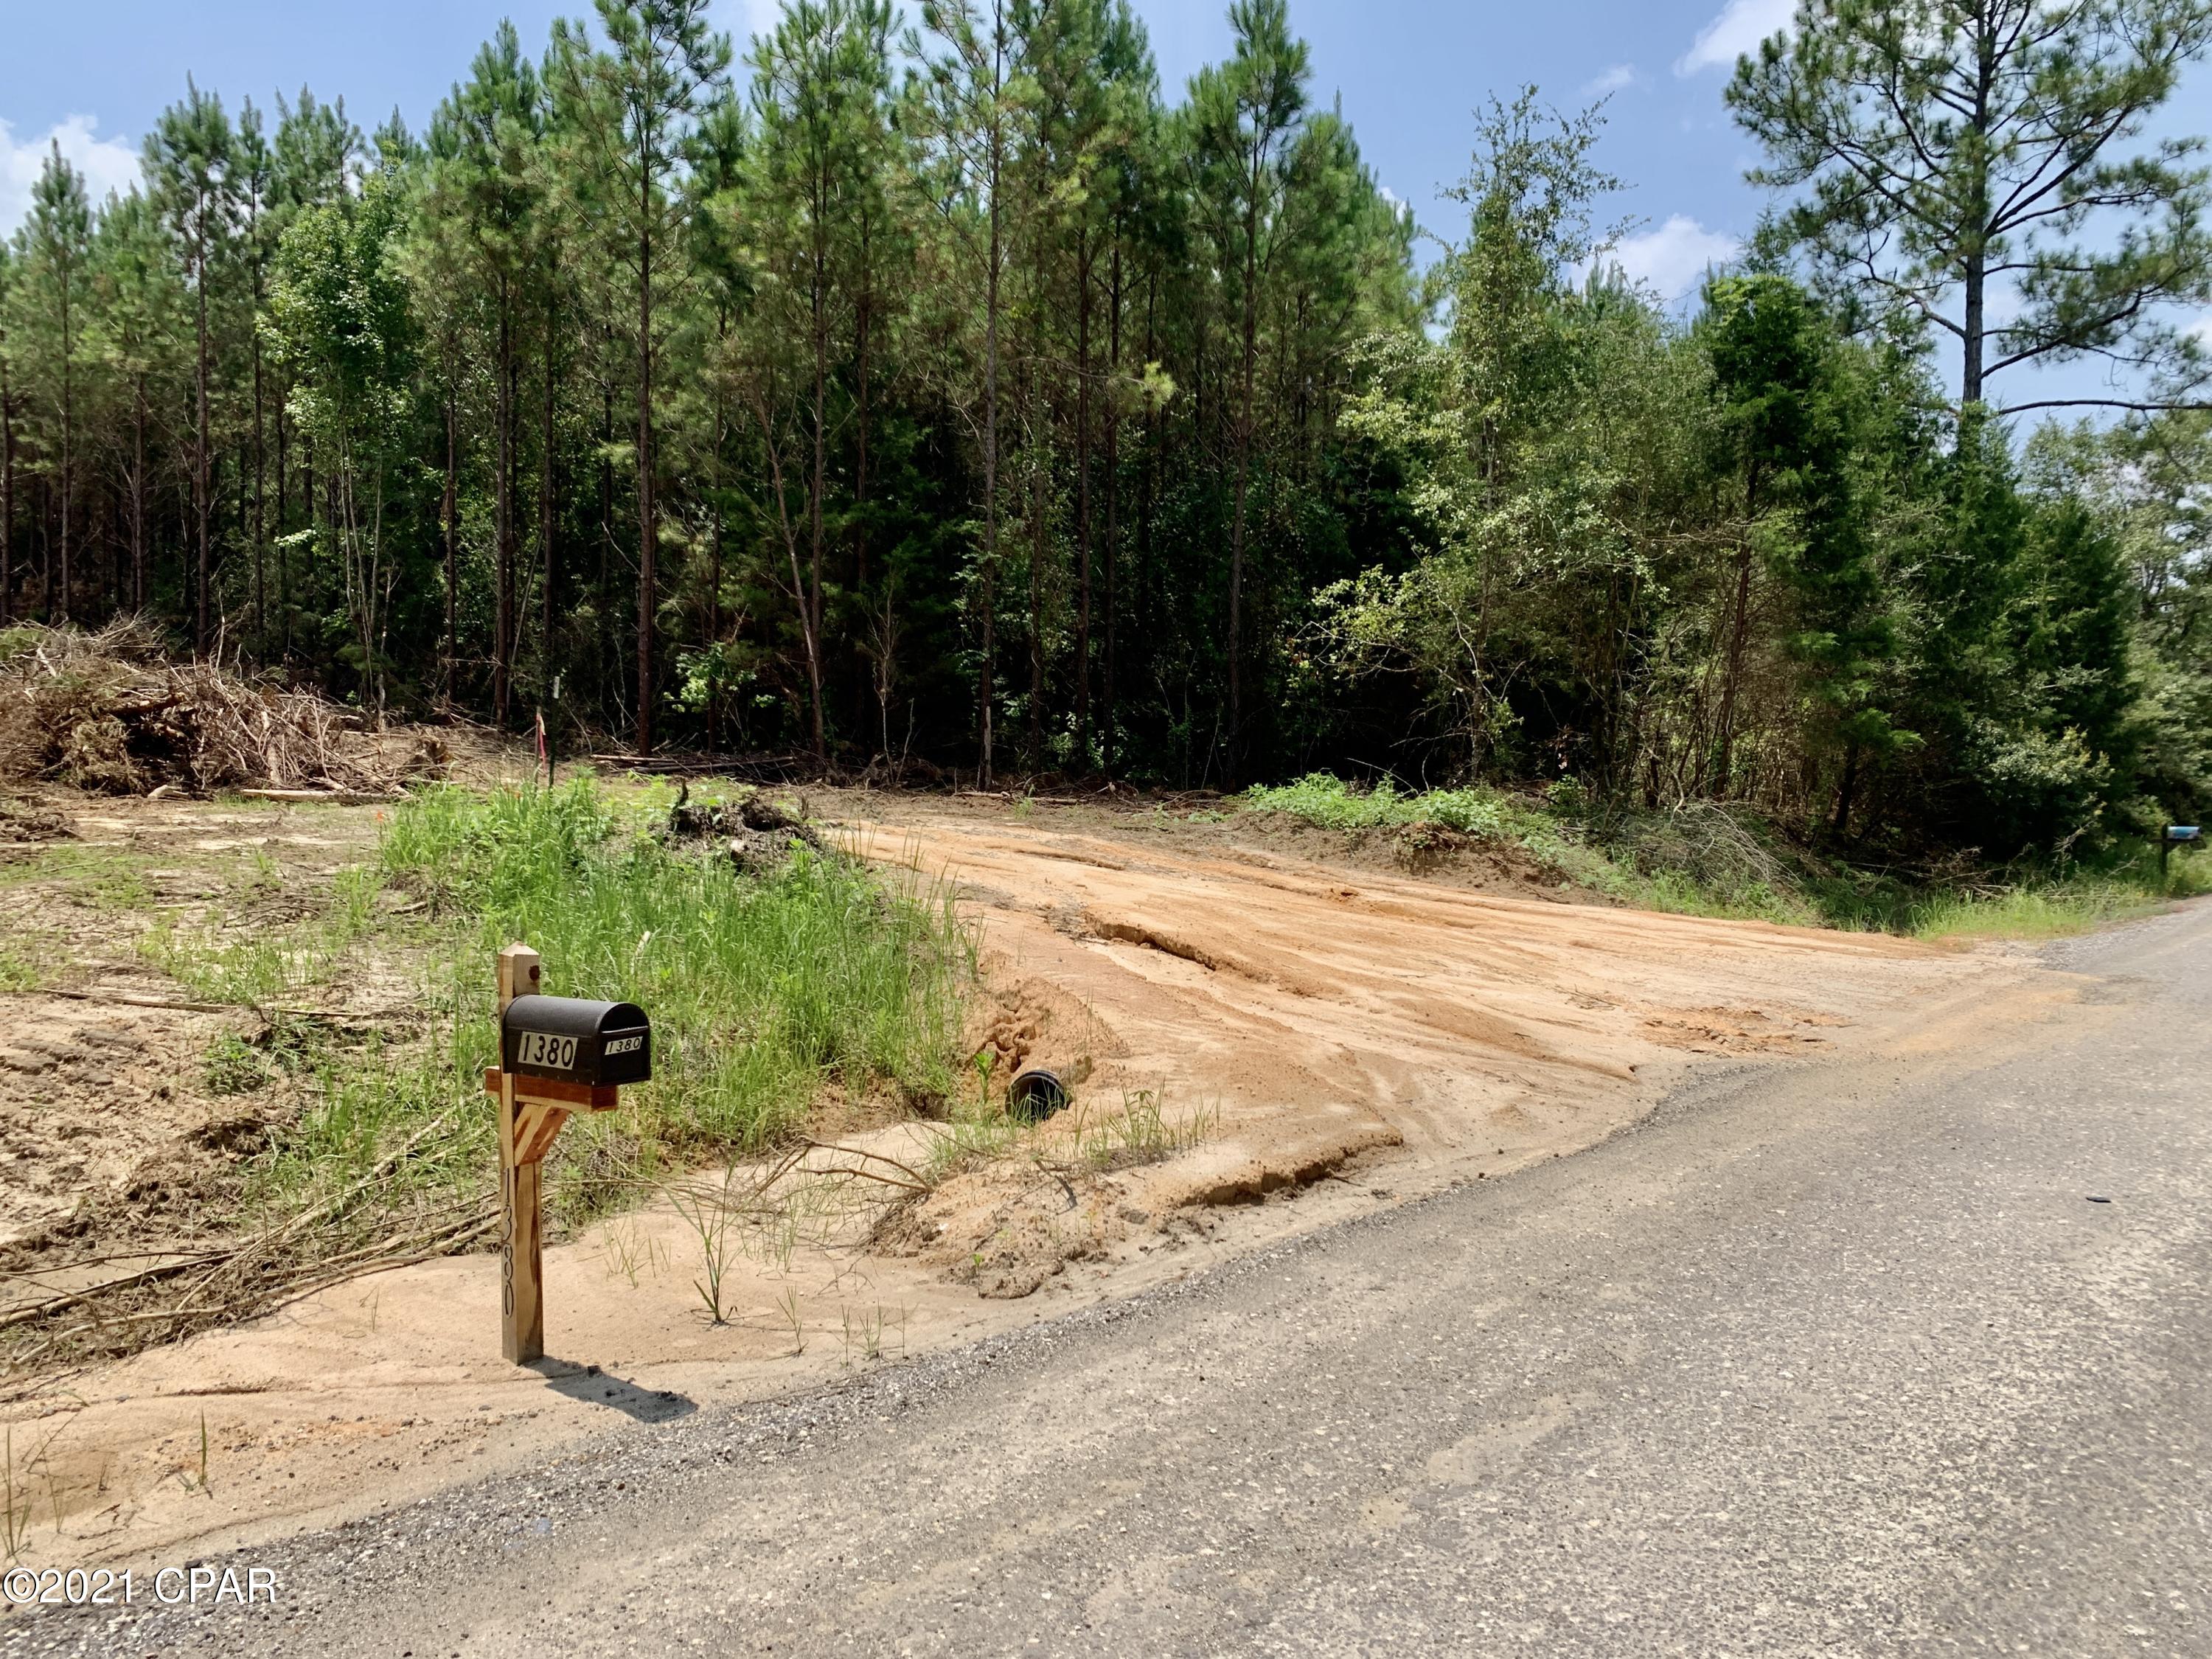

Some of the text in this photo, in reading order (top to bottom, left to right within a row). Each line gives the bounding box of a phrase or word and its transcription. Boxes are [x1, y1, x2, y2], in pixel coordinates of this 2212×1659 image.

[523, 1034, 574, 1068] 1380
[608, 1037, 641, 1053] 1380
[502, 1166, 515, 1319] 1380
